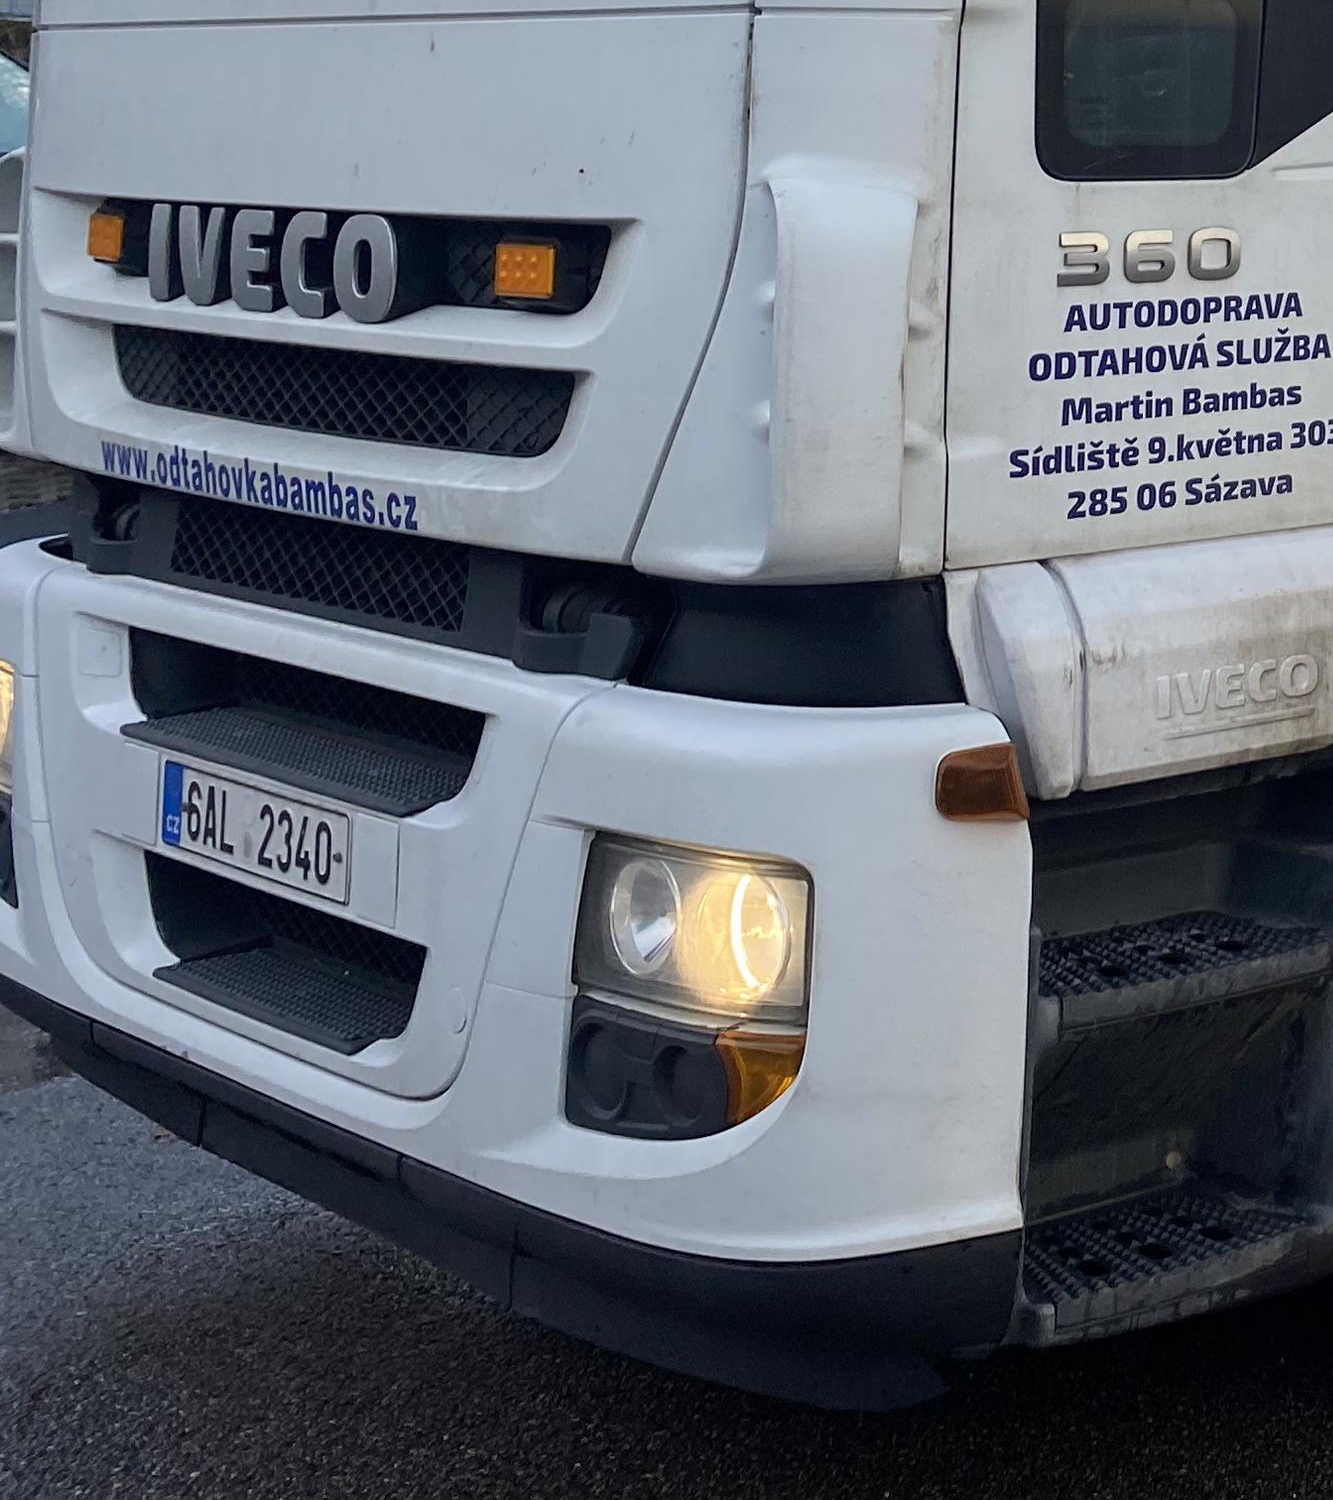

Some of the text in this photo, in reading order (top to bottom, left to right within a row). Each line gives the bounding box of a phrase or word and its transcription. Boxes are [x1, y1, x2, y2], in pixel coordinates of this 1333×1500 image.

[148, 203, 397, 323] IVECO
[1057, 227, 1241, 287] 360
[1063, 292, 1303, 332] AUTODOPRAVA
[1028, 327, 1331, 382] ODTAHOVÁ SLUŽBA
[1061, 382, 1302, 426] Martin Bambas
[1009, 436, 1139, 478] Sídliště
[1148, 427, 1283, 464] 9.května
[101, 440, 418, 530] www.odtahovkabambas.cz
[1067, 473, 1293, 520] 285 06 Sázava
[1156, 654, 1320, 720] IVECO
[166, 815, 180, 834] CZ
[186, 781, 332, 885] 6AL 2340
